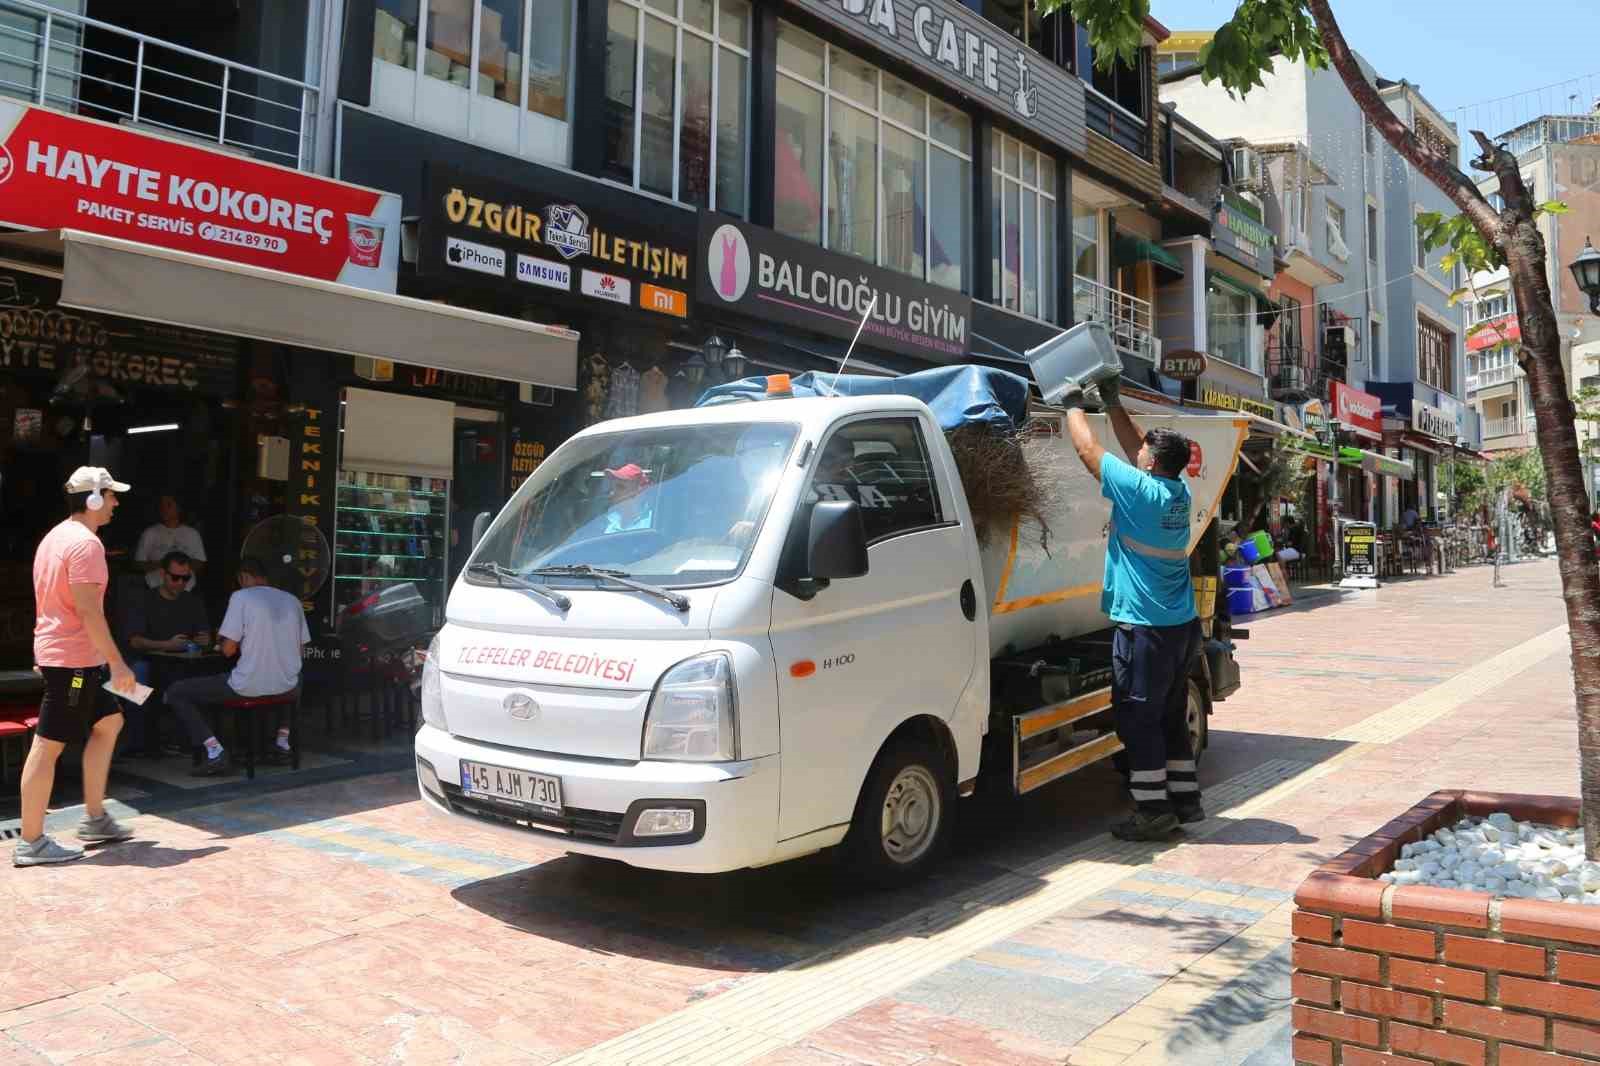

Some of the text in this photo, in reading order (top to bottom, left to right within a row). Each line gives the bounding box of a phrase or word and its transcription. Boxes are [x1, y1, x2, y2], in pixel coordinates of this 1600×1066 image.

[913, 5, 999, 92] CAFE
[26, 140, 161, 202] HAYTE
[168, 174, 335, 245] KOKOREÇ
[77, 199, 135, 225] PAKET
[219, 230, 243, 244] 214
[245, 234, 260, 246] 89
[264, 238, 279, 250] 90
[446, 188, 688, 280] ÖZGÜR İLETİŞİM
[463, 247, 503, 268] iPhone
[519, 261, 568, 284] SAMSUNG
[758, 253, 966, 345] BALCIOĞLU GİYİM
[1165, 358, 1201, 371] BTM
[533, 649, 637, 683] BELEDİYESİ
[472, 765, 557, 803] 45 AJM 730
